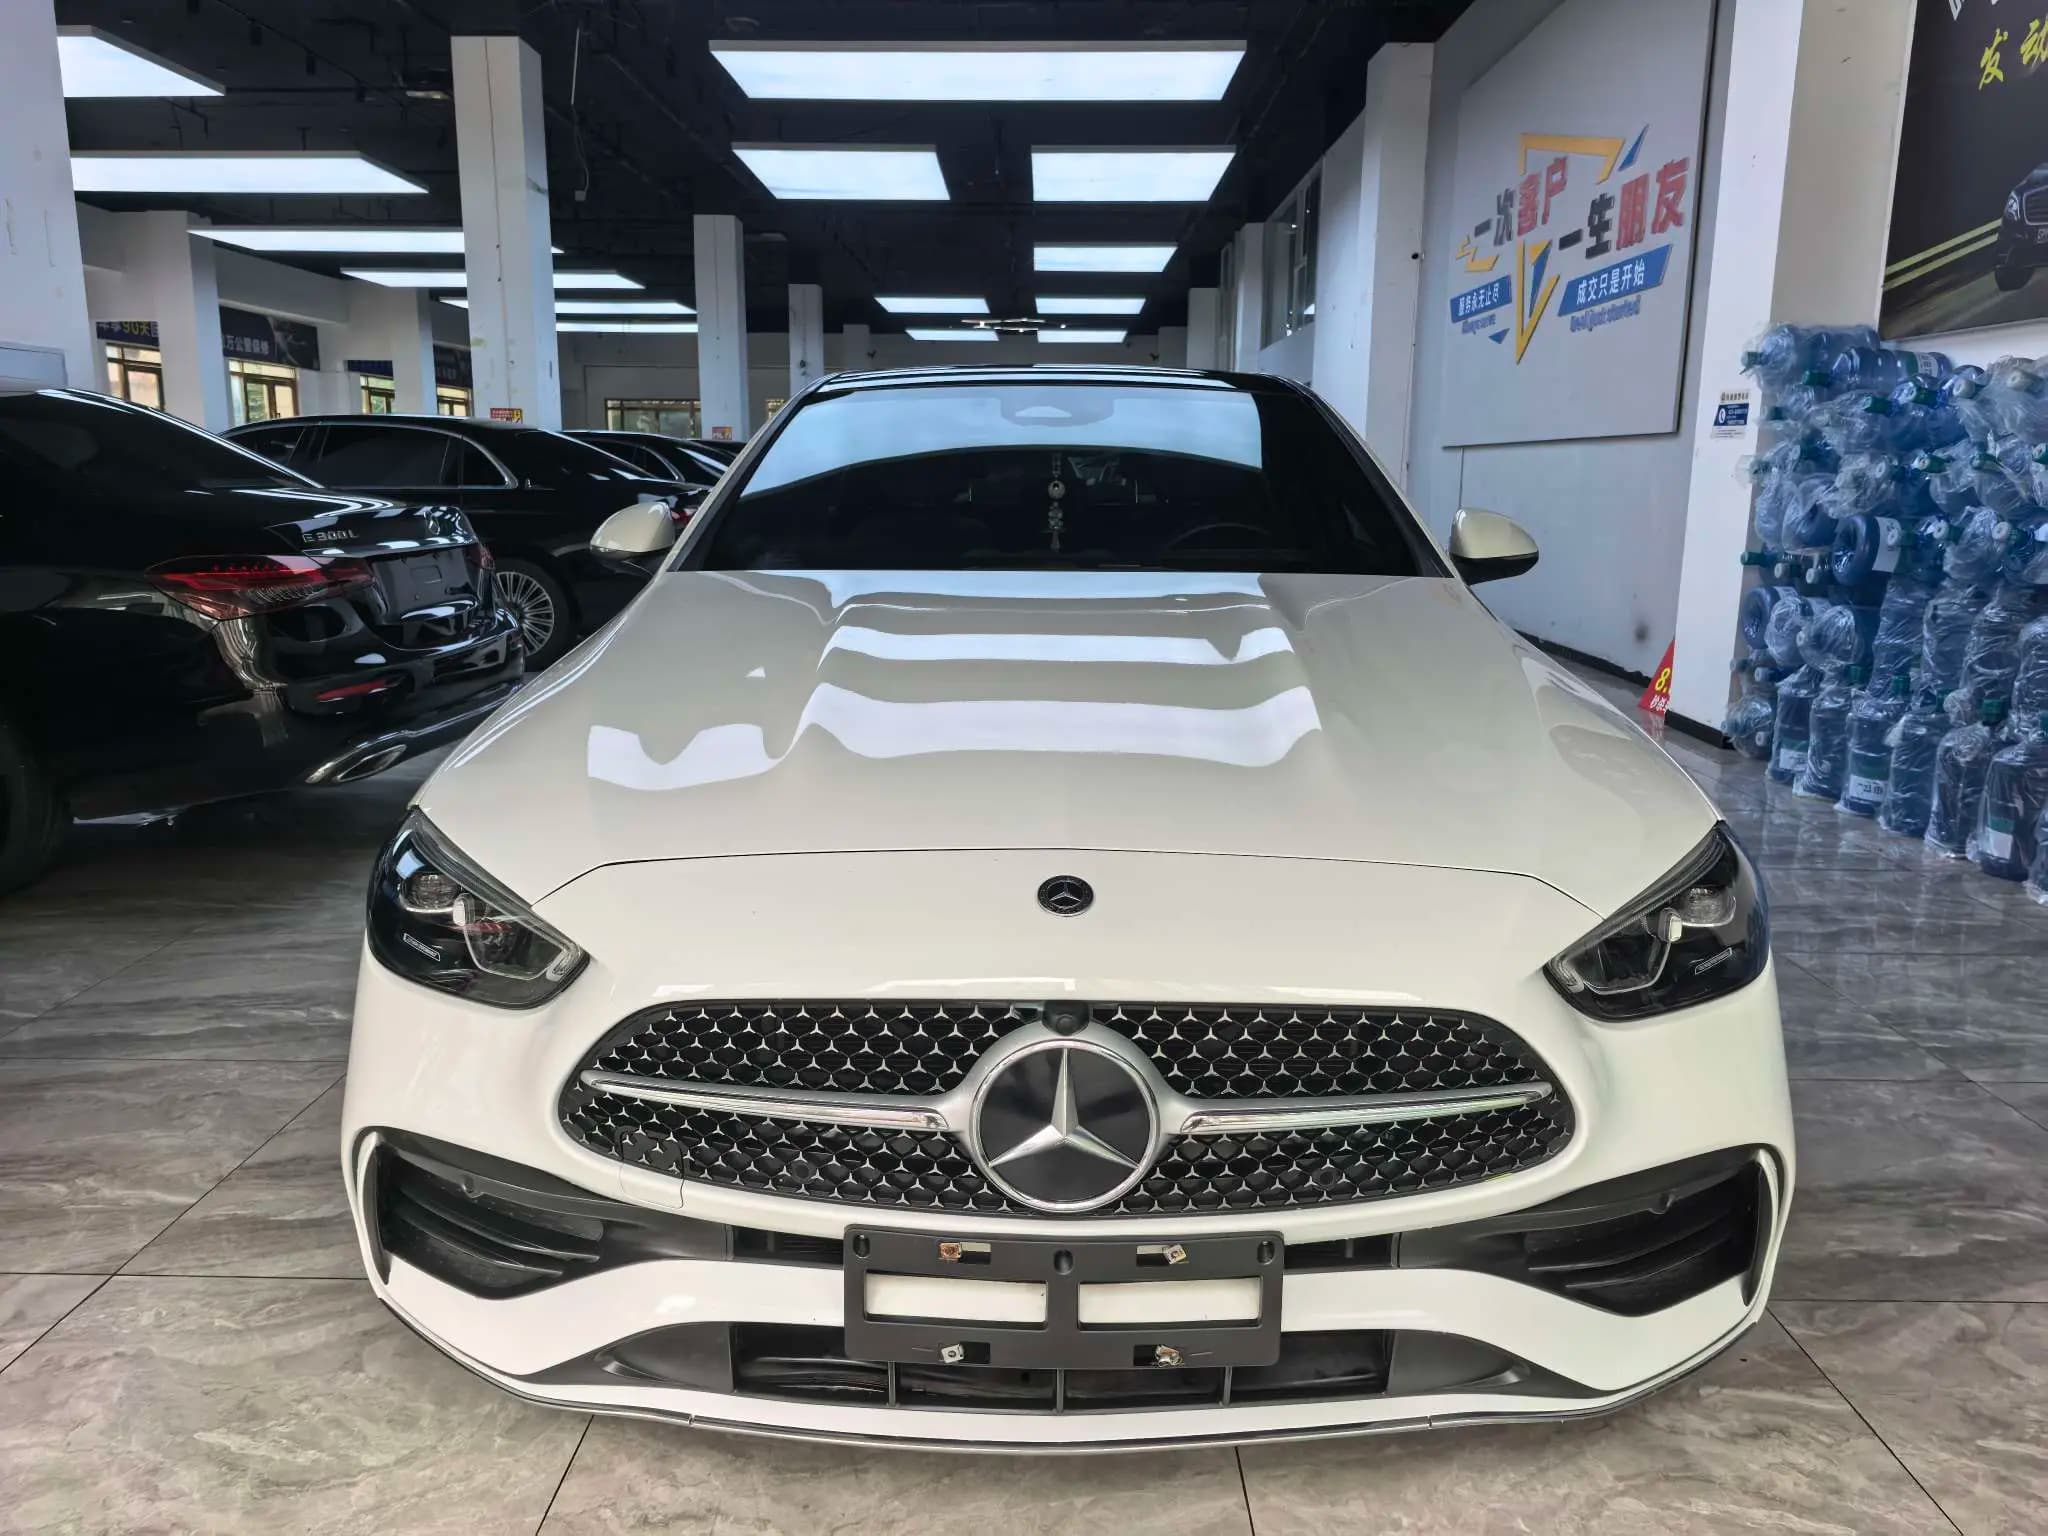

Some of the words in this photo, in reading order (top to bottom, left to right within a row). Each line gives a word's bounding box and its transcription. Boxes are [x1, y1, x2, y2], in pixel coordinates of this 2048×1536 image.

[1474, 156, 1567, 247] 一次客户
[1559, 157, 1690, 259] 一生朋友
[1577, 258, 1646, 304] 成交只是开始
[224, 334, 269, 355] 万公里保修
